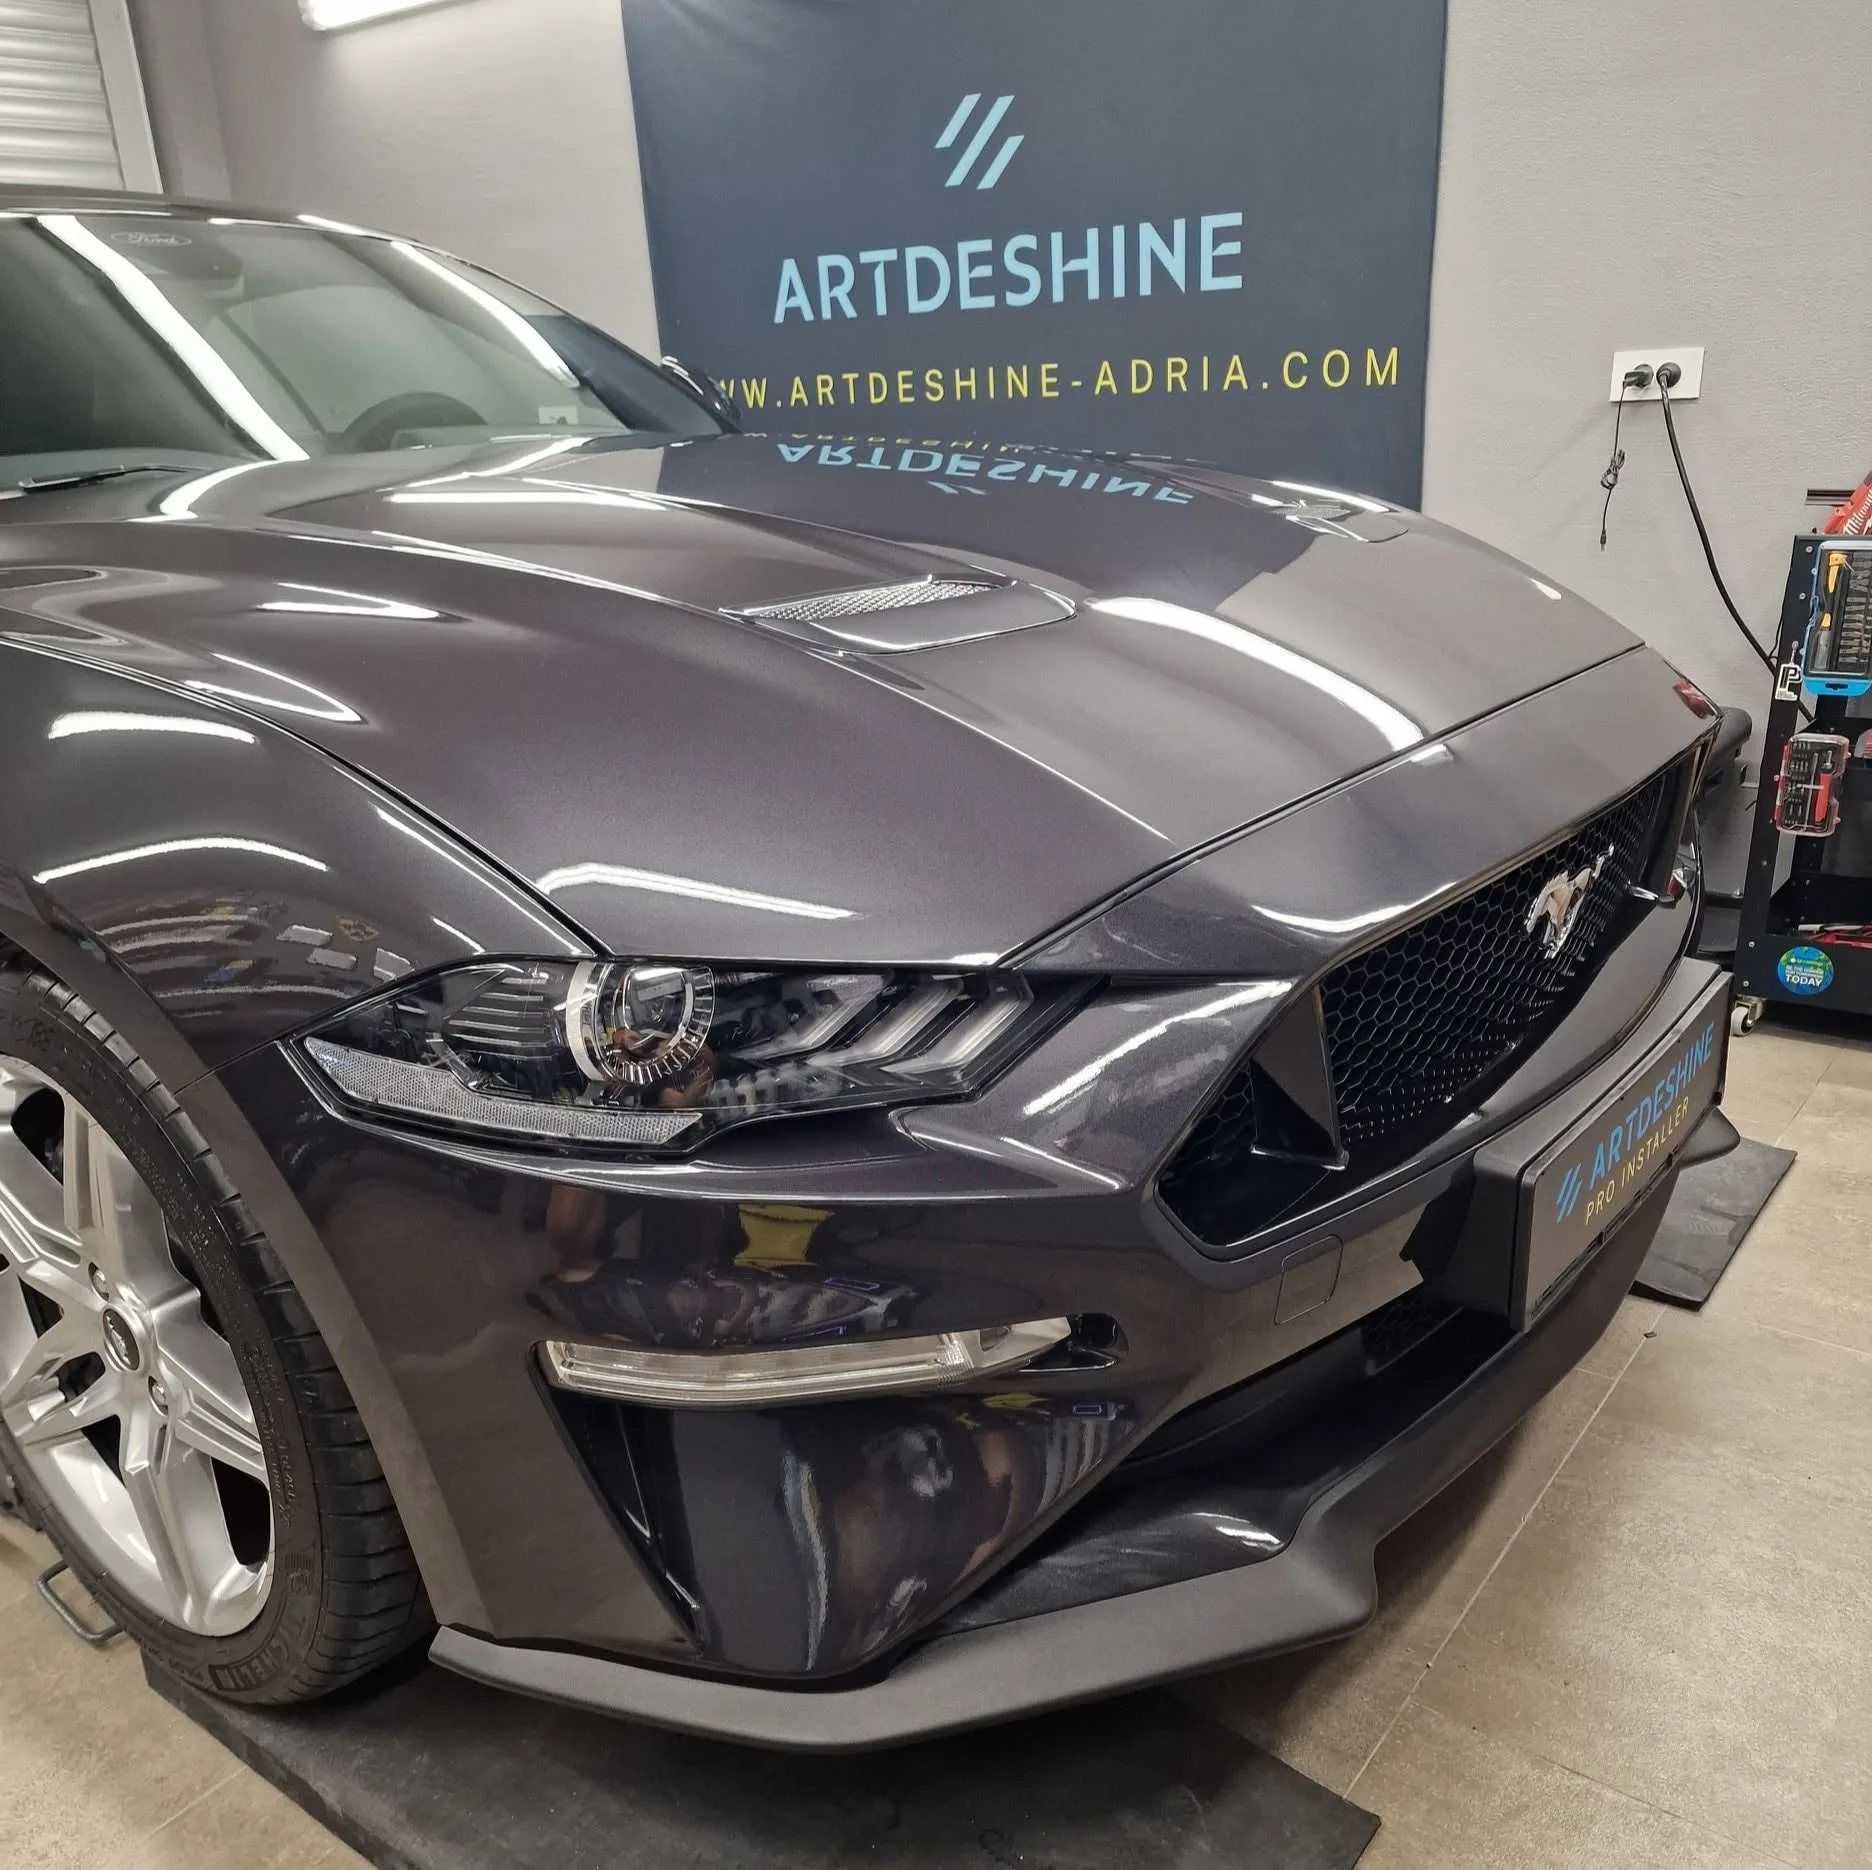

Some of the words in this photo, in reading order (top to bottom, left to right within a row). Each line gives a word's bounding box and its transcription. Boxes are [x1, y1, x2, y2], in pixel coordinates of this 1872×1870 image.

[775, 212, 1243, 323] ARTDESHINE
[1785, 974, 1823, 988] TODAY
[1586, 1180, 1615, 1226] PRO
[1621, 1096, 1689, 1188] INSTALLER
[1589, 1021, 1714, 1190] ARTDESHINE
